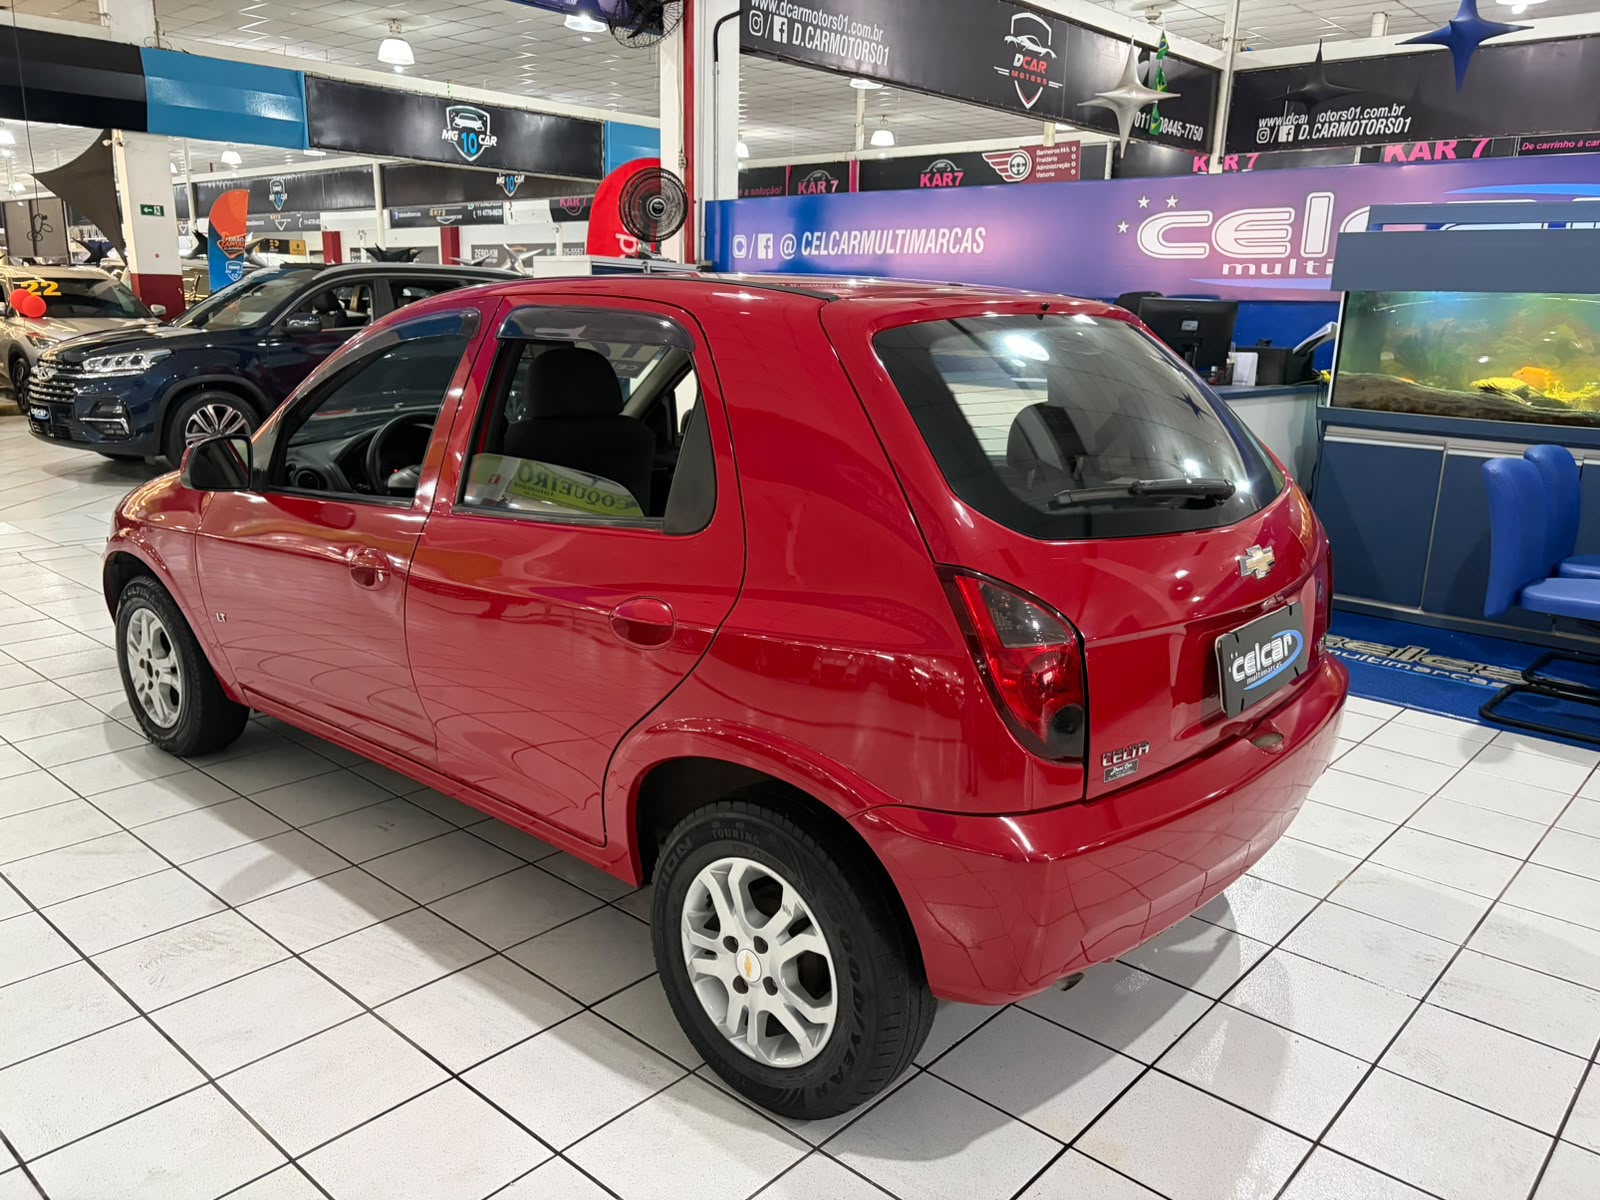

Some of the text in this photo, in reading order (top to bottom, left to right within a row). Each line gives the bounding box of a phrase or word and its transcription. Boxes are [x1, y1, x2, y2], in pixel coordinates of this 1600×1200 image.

[751, 0, 883, 41] www.dcarmotors01.com.br
[792, 22, 890, 66] D.CARMOTORS01
[1012, 53, 1048, 74] DCAR
[1011, 70, 1047, 85] MOTORS
[1258, 103, 1406, 127] www.dcarotors01.com.br
[441, 129, 497, 155] MG 10 CAR
[1036, 148, 1060, 156] Banheiros
[1383, 137, 1491, 163] KAR 7
[1521, 142, 1534, 150] De
[1536, 140, 1575, 150] carrinho
[1036, 161, 1071, 171] Administração
[1192, 152, 1261, 173] KR 7
[506, 175, 514, 192] 10
[514, 174, 525, 183] CAR
[798, 179, 839, 194] KAR 7
[801, 226, 986, 256] CELCARMULTIMARCAS
[21, 281, 62, 296] 22
[216, 612, 226, 623] LT
[1232, 633, 1292, 682] celcar
[1246, 661, 1282, 685] multimarcas
[1102, 741, 1149, 767] CELTA
[711, 828, 760, 845] TOURING
